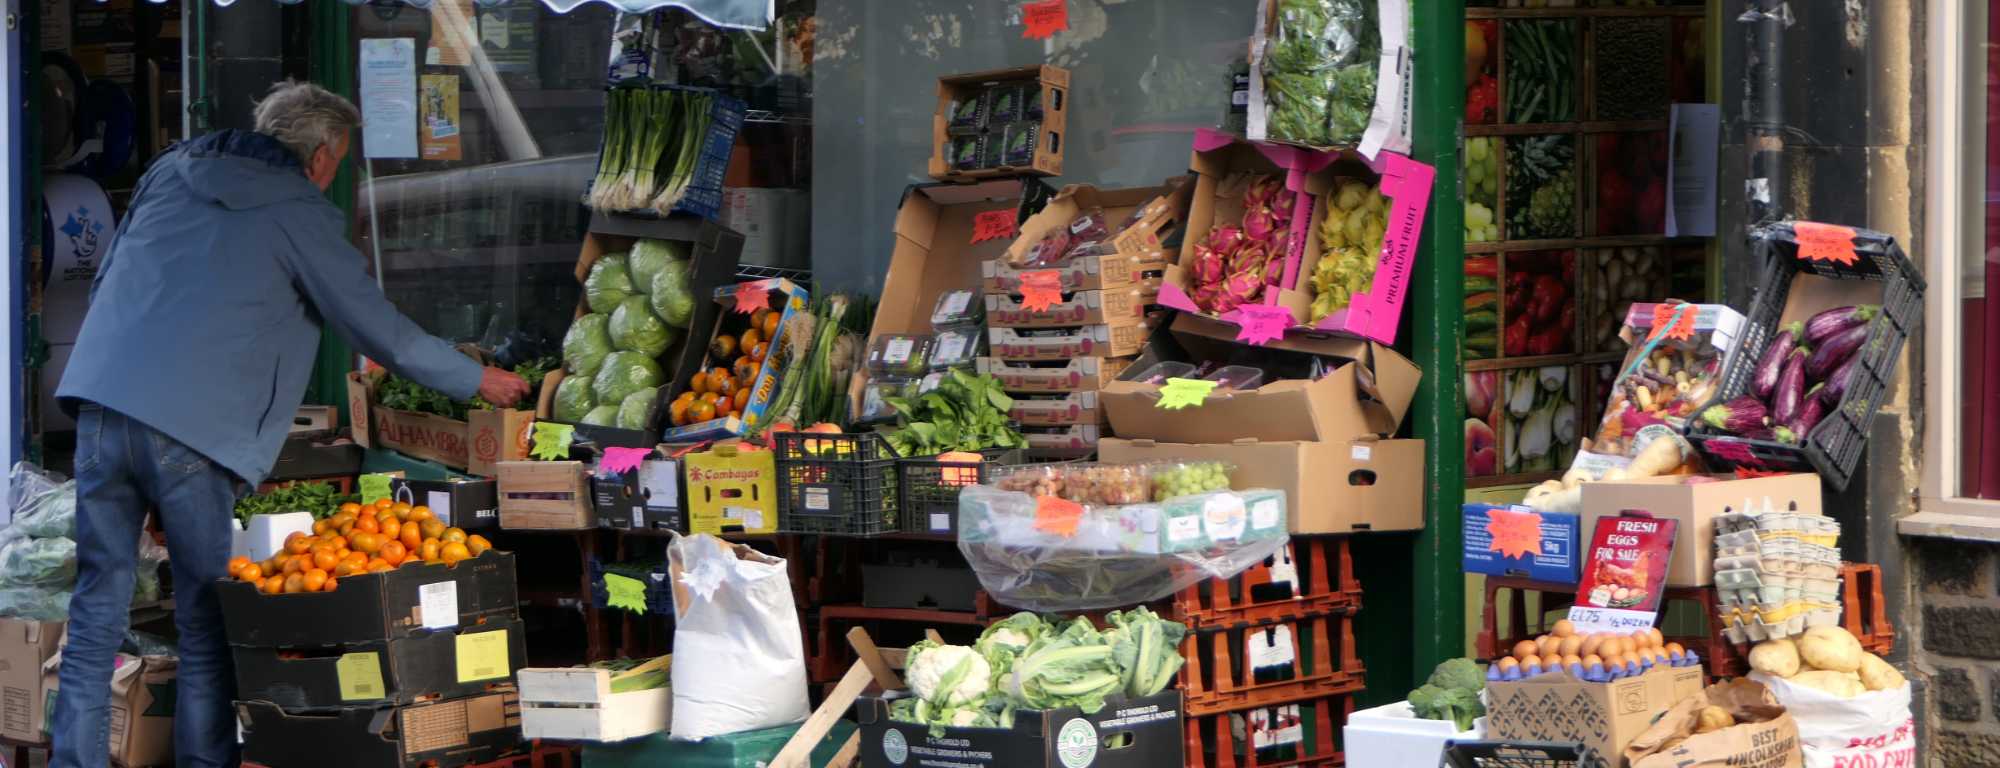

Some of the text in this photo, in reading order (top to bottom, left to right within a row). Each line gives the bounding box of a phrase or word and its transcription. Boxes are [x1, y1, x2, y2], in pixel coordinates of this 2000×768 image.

[1385, 243, 1409, 305] PREMIUM
[1401, 203, 1417, 241] FRUIT
[379, 415, 468, 457] ALHAMBRA
[1616, 520, 1658, 533] FRESH
[1544, 540, 1560, 554] 5kg
[1606, 534, 1639, 546] EGGS
[1594, 547, 1640, 561] FOR SALE
[1621, 617, 1651, 628] DOZEN
[1752, 728, 1778, 748] BEST
